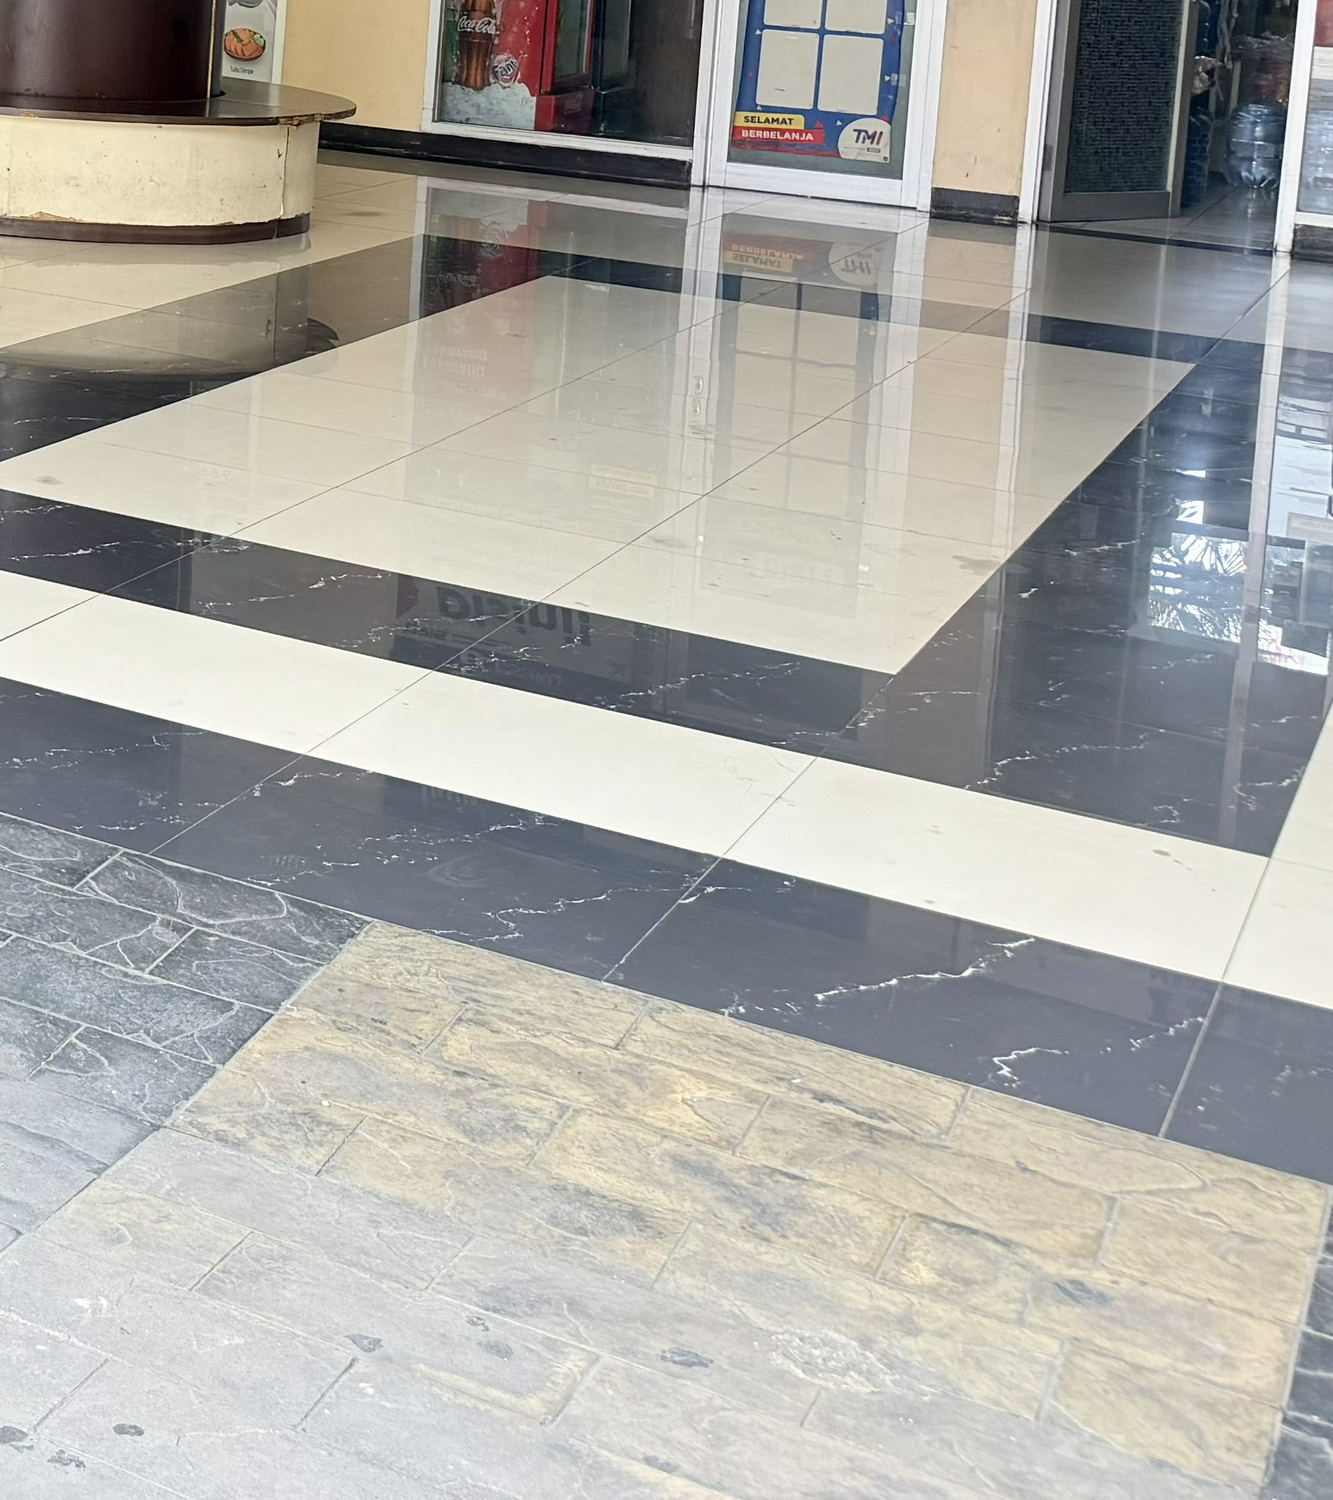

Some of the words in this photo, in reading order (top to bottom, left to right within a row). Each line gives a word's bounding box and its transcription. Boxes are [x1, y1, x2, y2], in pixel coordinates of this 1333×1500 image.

[743, 115, 794, 125] SELAMAT
[741, 129, 814, 141] BERBELANJA
[852, 129, 884, 145] TMI
